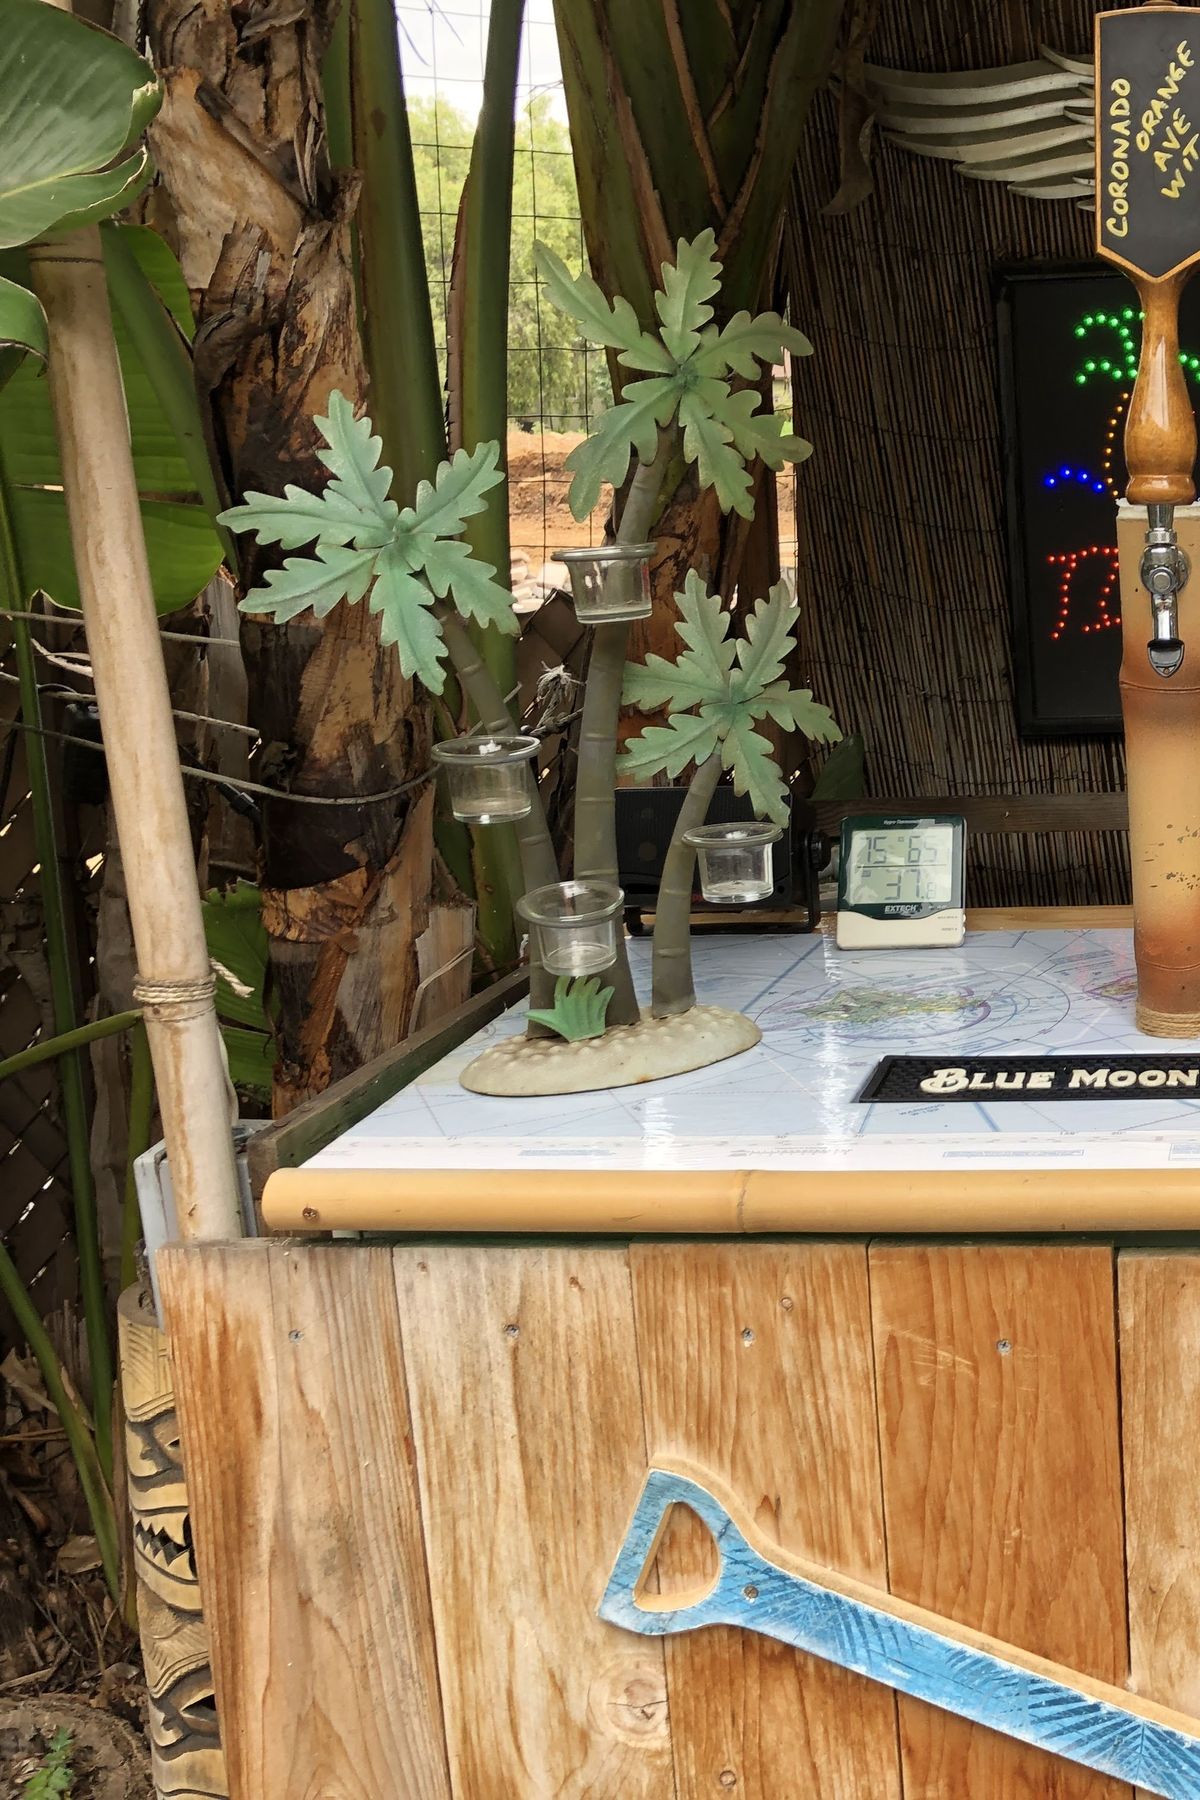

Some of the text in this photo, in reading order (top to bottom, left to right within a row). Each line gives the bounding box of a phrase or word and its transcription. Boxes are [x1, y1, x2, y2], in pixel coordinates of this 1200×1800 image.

[1136, 40, 1195, 152] ORANGE
[1106, 78, 1131, 238] CORONADO
[1153, 107, 1191, 172] AVE
[1160, 133, 1199, 198] WIT
[884, 905, 917, 913] EXTECH
[919, 1066, 1056, 1094] BLUE
[1068, 1067, 1200, 1090] MOON
